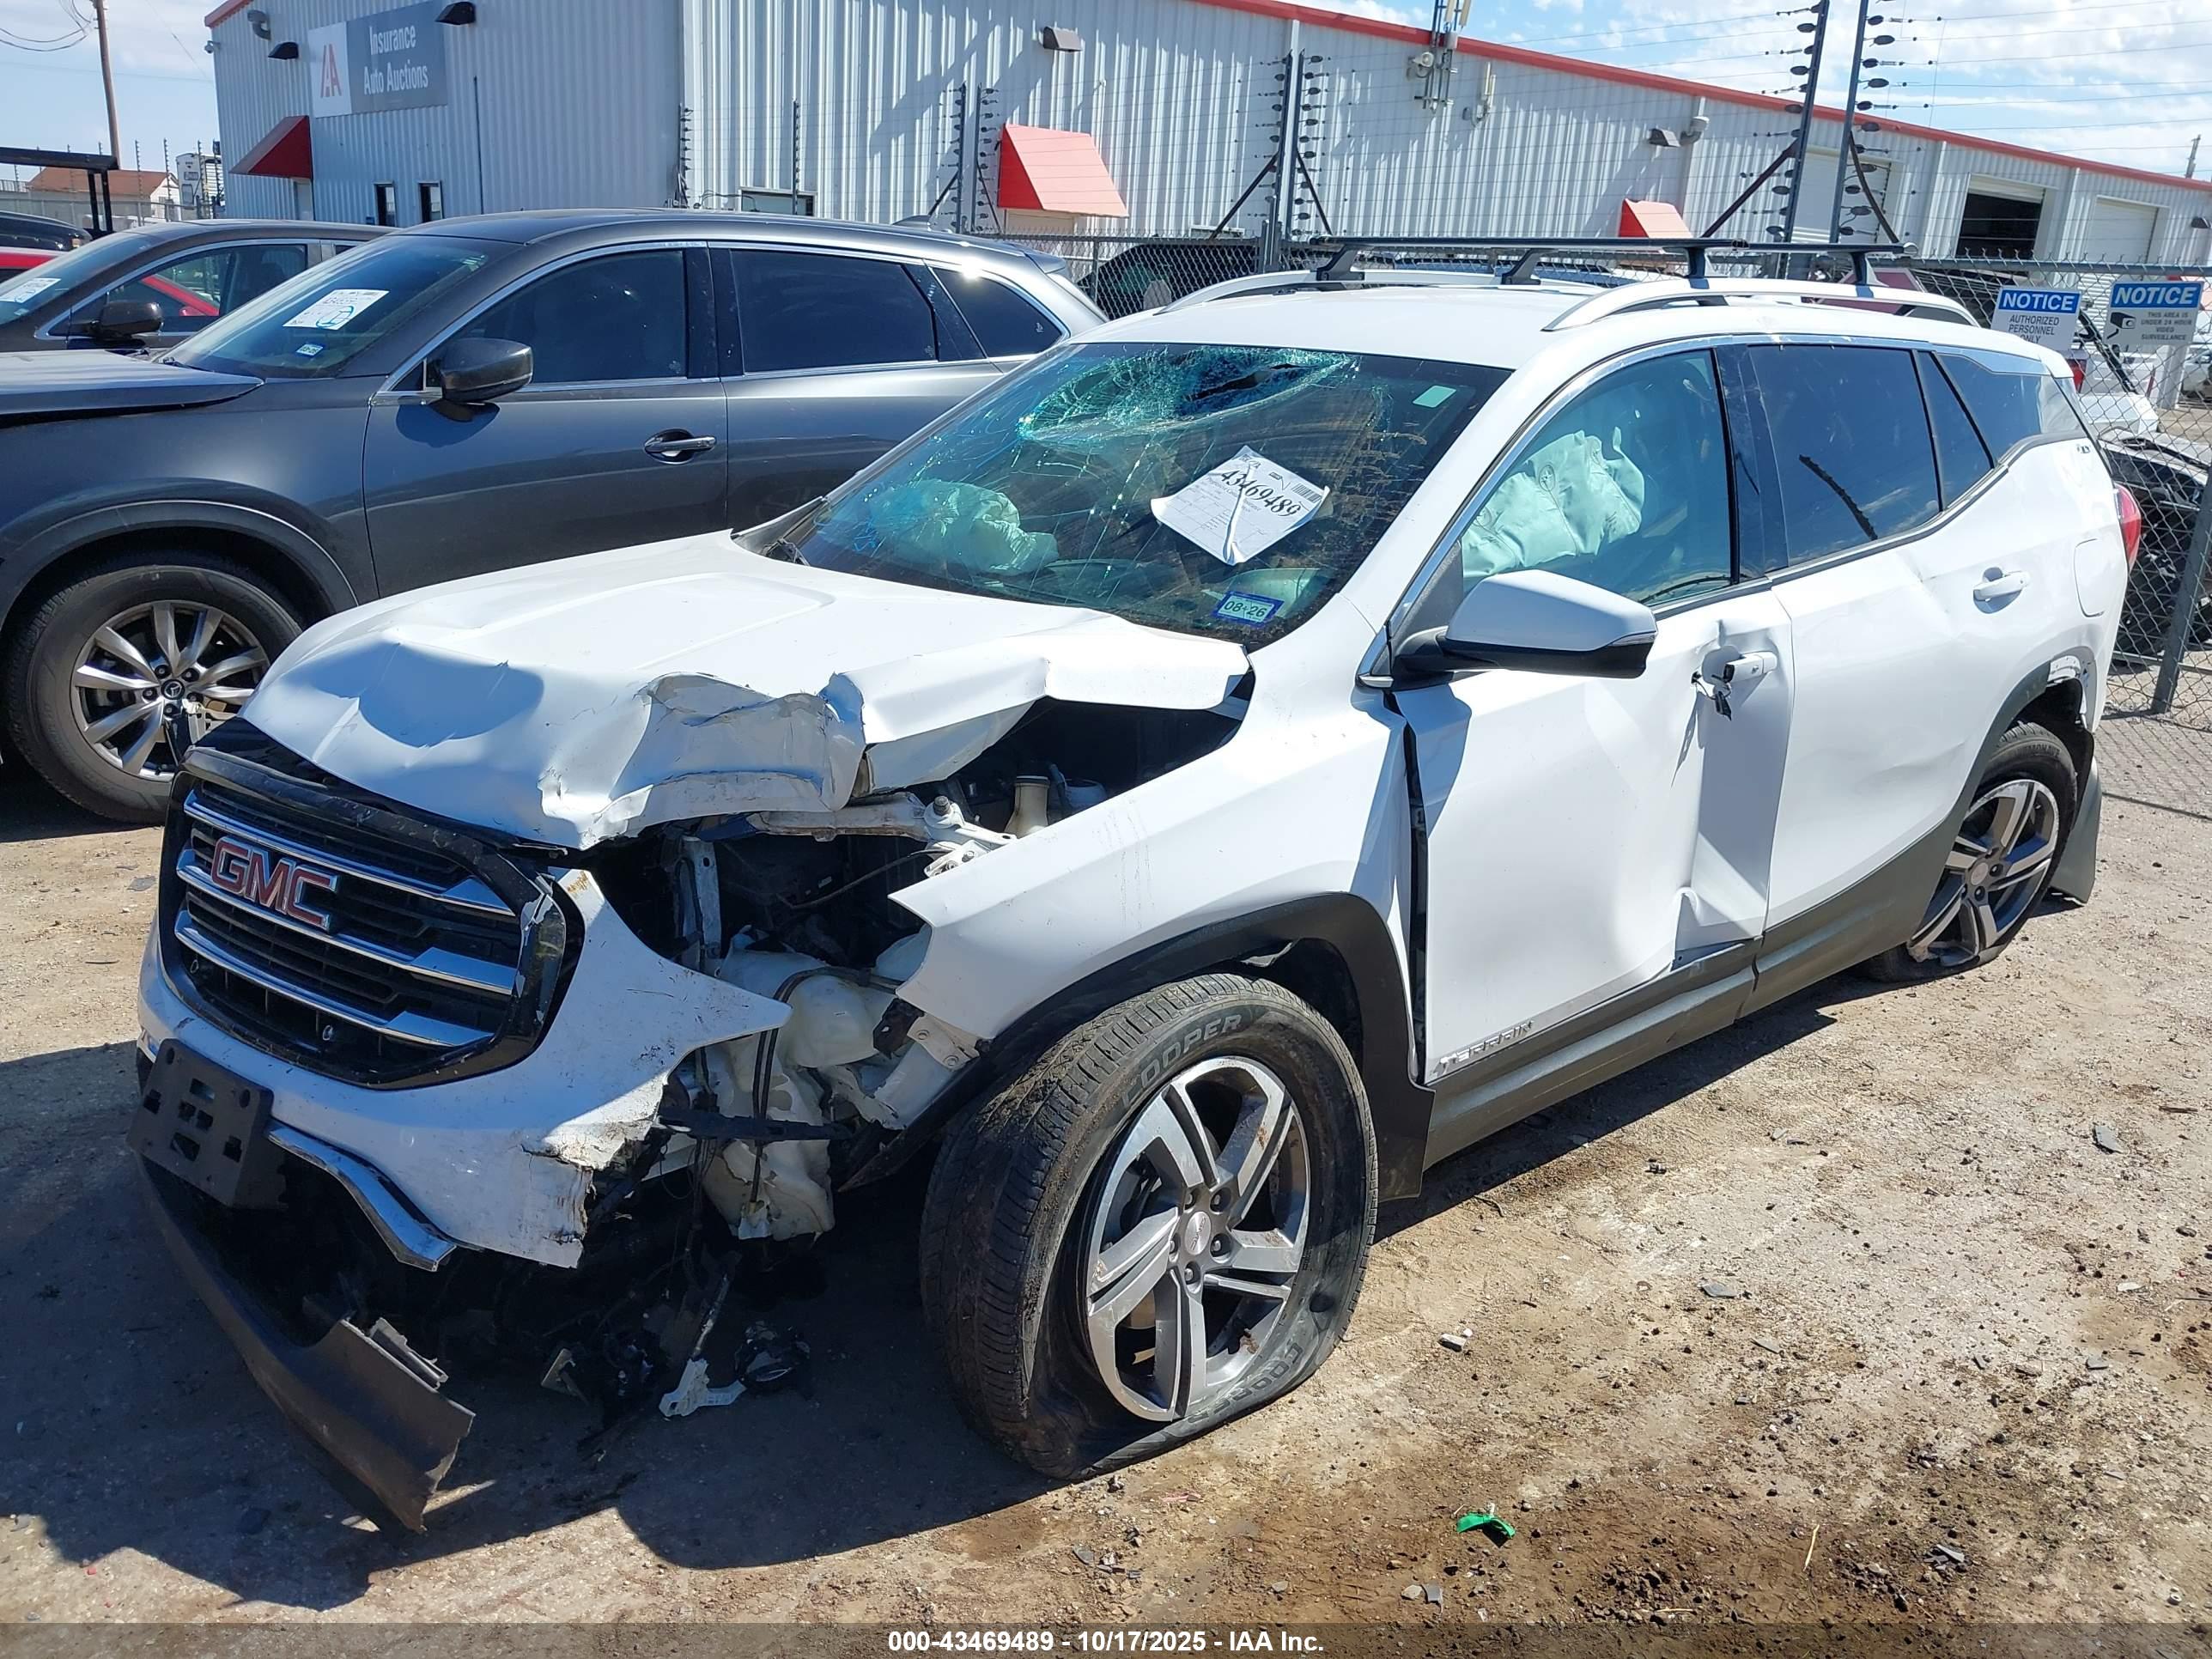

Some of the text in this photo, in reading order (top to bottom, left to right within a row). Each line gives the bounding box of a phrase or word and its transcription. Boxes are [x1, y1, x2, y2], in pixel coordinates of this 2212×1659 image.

[369, 25, 416, 56] Insurance
[364, 59, 428, 95] Auto Auctions
[2002, 293, 2075, 311] NOTICE
[2114, 287, 2197, 305] NOTICE
[2008, 325, 2055, 335] PERSONNEL
[2009, 314, 2059, 325] AUTHORIZED
[1221, 470, 1302, 516] 43469489
[211, 835, 339, 933] GMC
